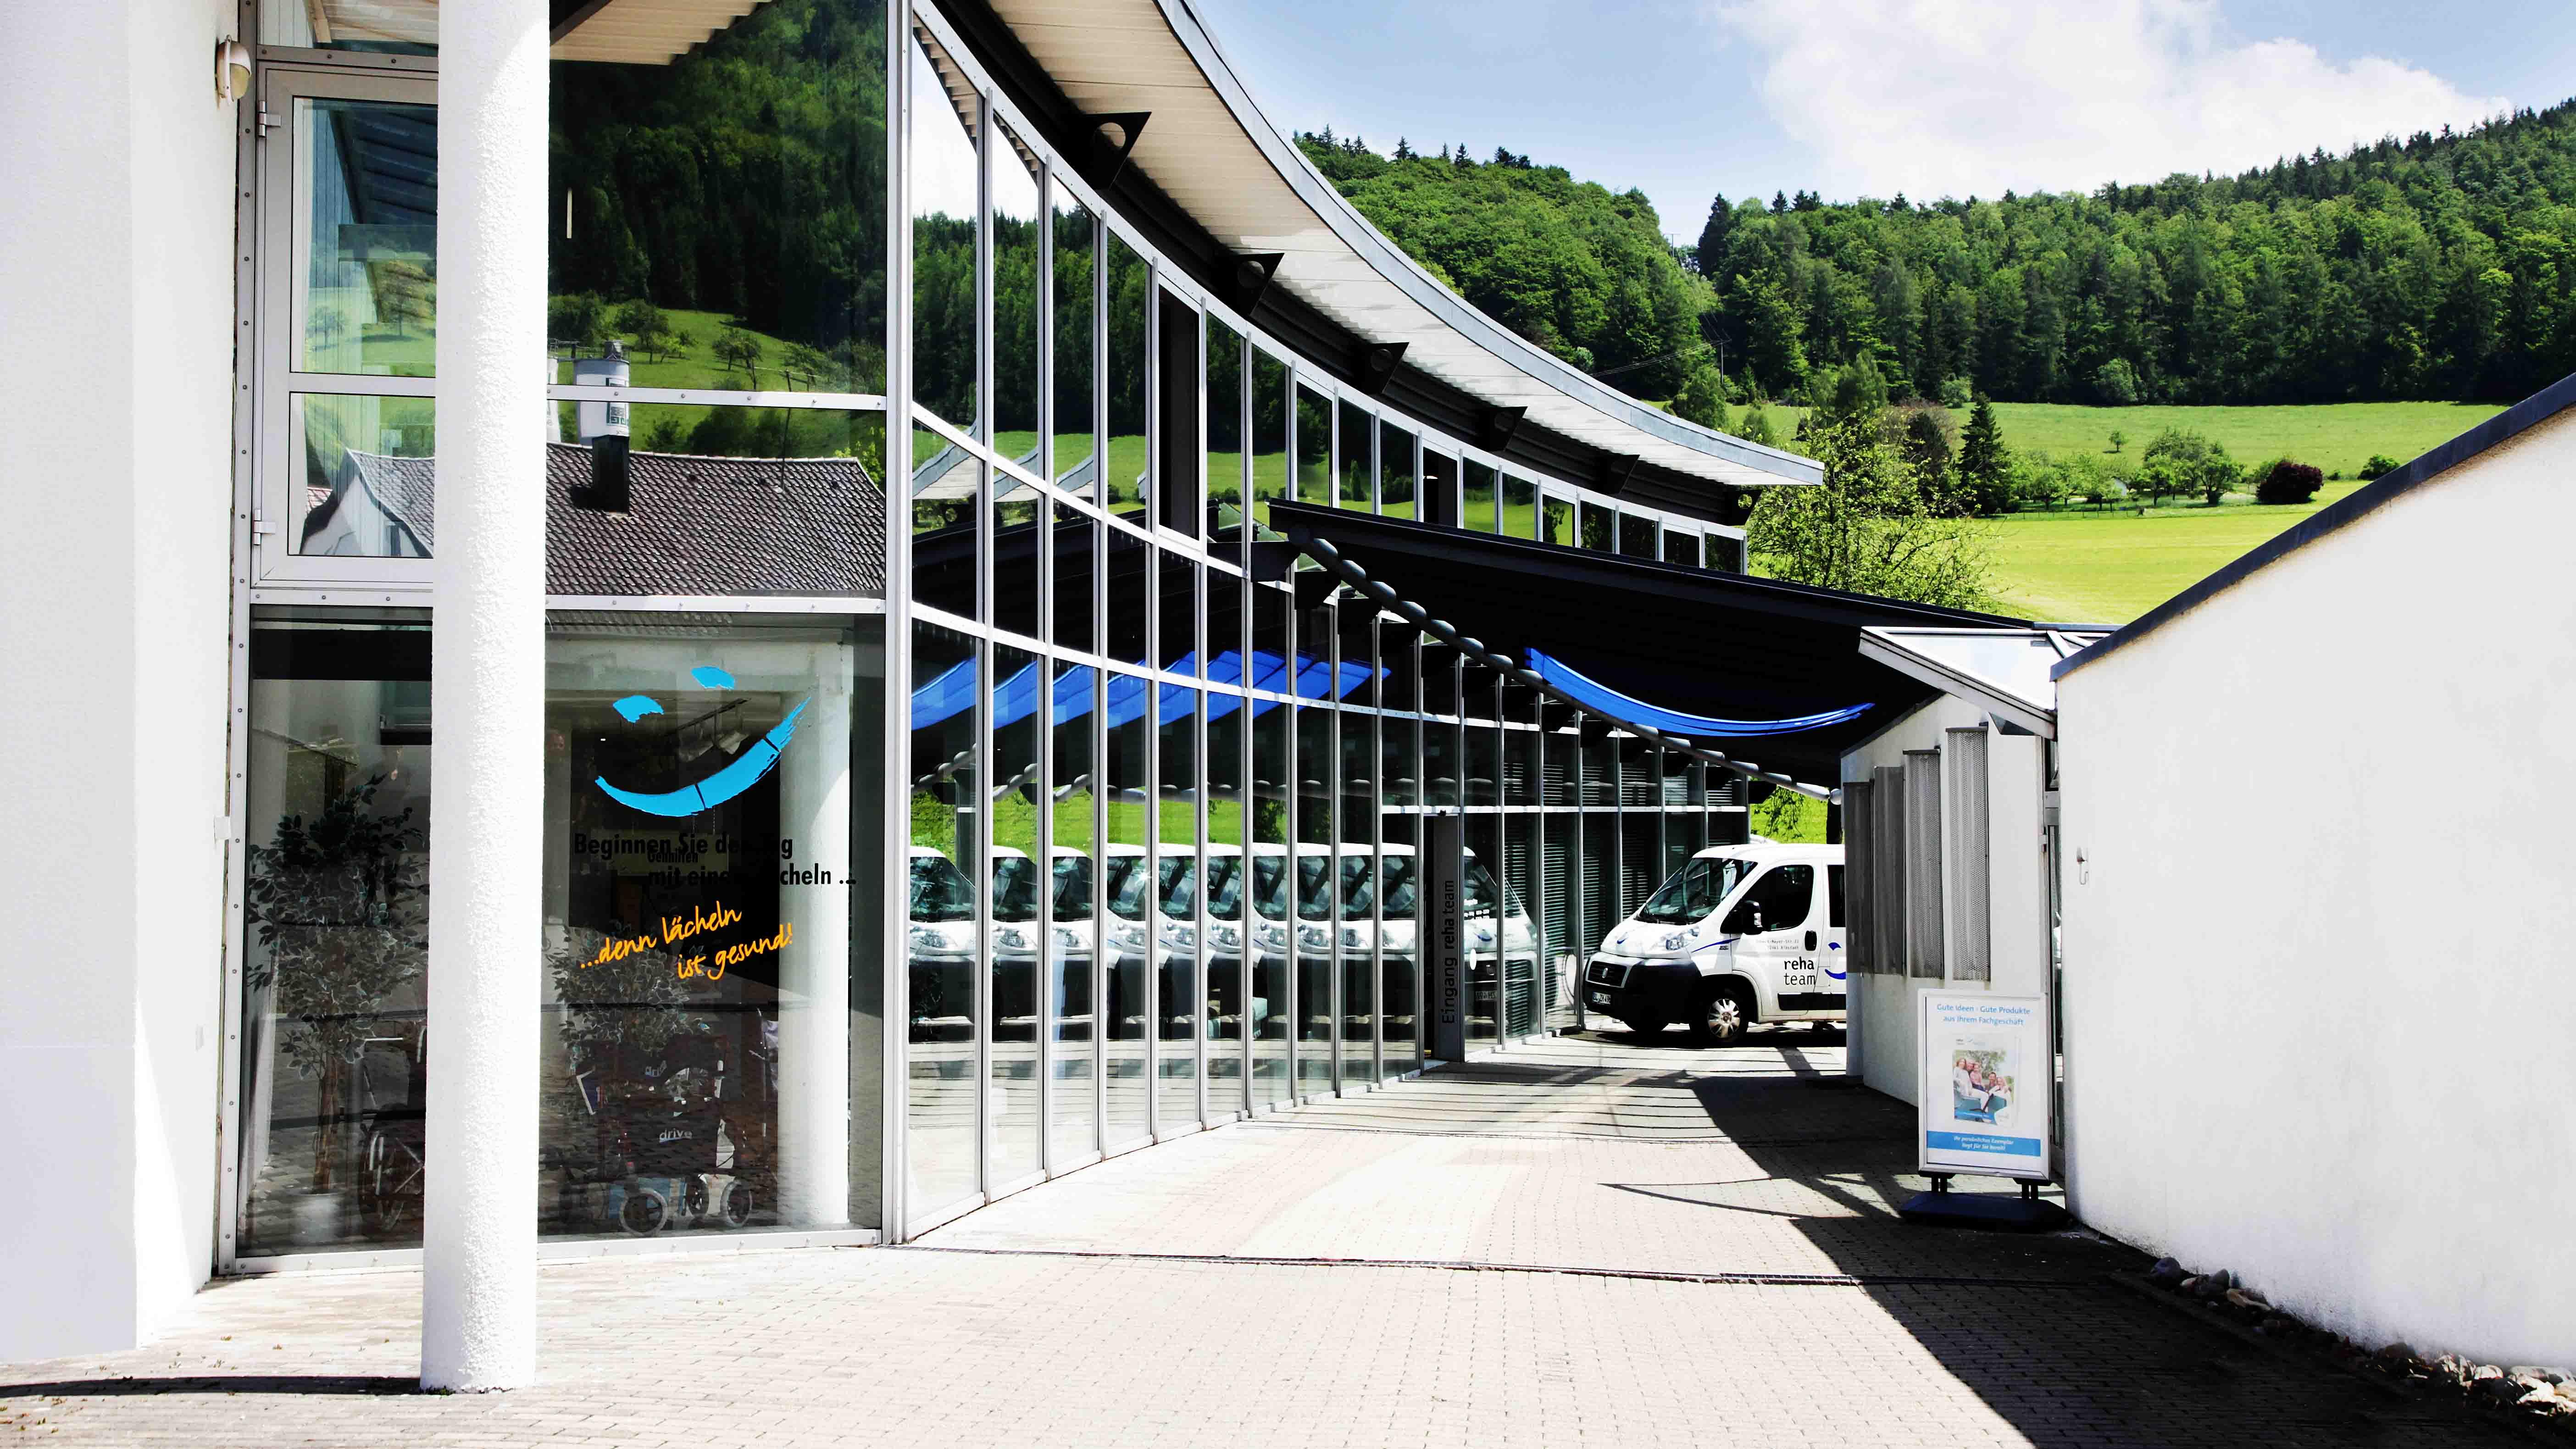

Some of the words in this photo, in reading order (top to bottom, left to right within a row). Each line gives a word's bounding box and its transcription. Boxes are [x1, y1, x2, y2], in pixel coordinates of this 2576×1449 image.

[574, 833, 671, 860] Beginnen
[678, 832, 708, 854] Sie
[780, 863, 832, 885] cheln
[1443, 880, 1455, 914] team
[661, 900, 742, 945] lächeln
[1441, 919, 1455, 949] reha
[676, 953, 706, 980] ist
[706, 922, 794, 981] gesund!
[1784, 956, 1815, 970] reha
[1442, 957, 1457, 1023] Eingang
[1783, 973, 1816, 985] team
[1999, 1006, 2031, 1015] Produkte
[659, 1128, 693, 1140] drive
